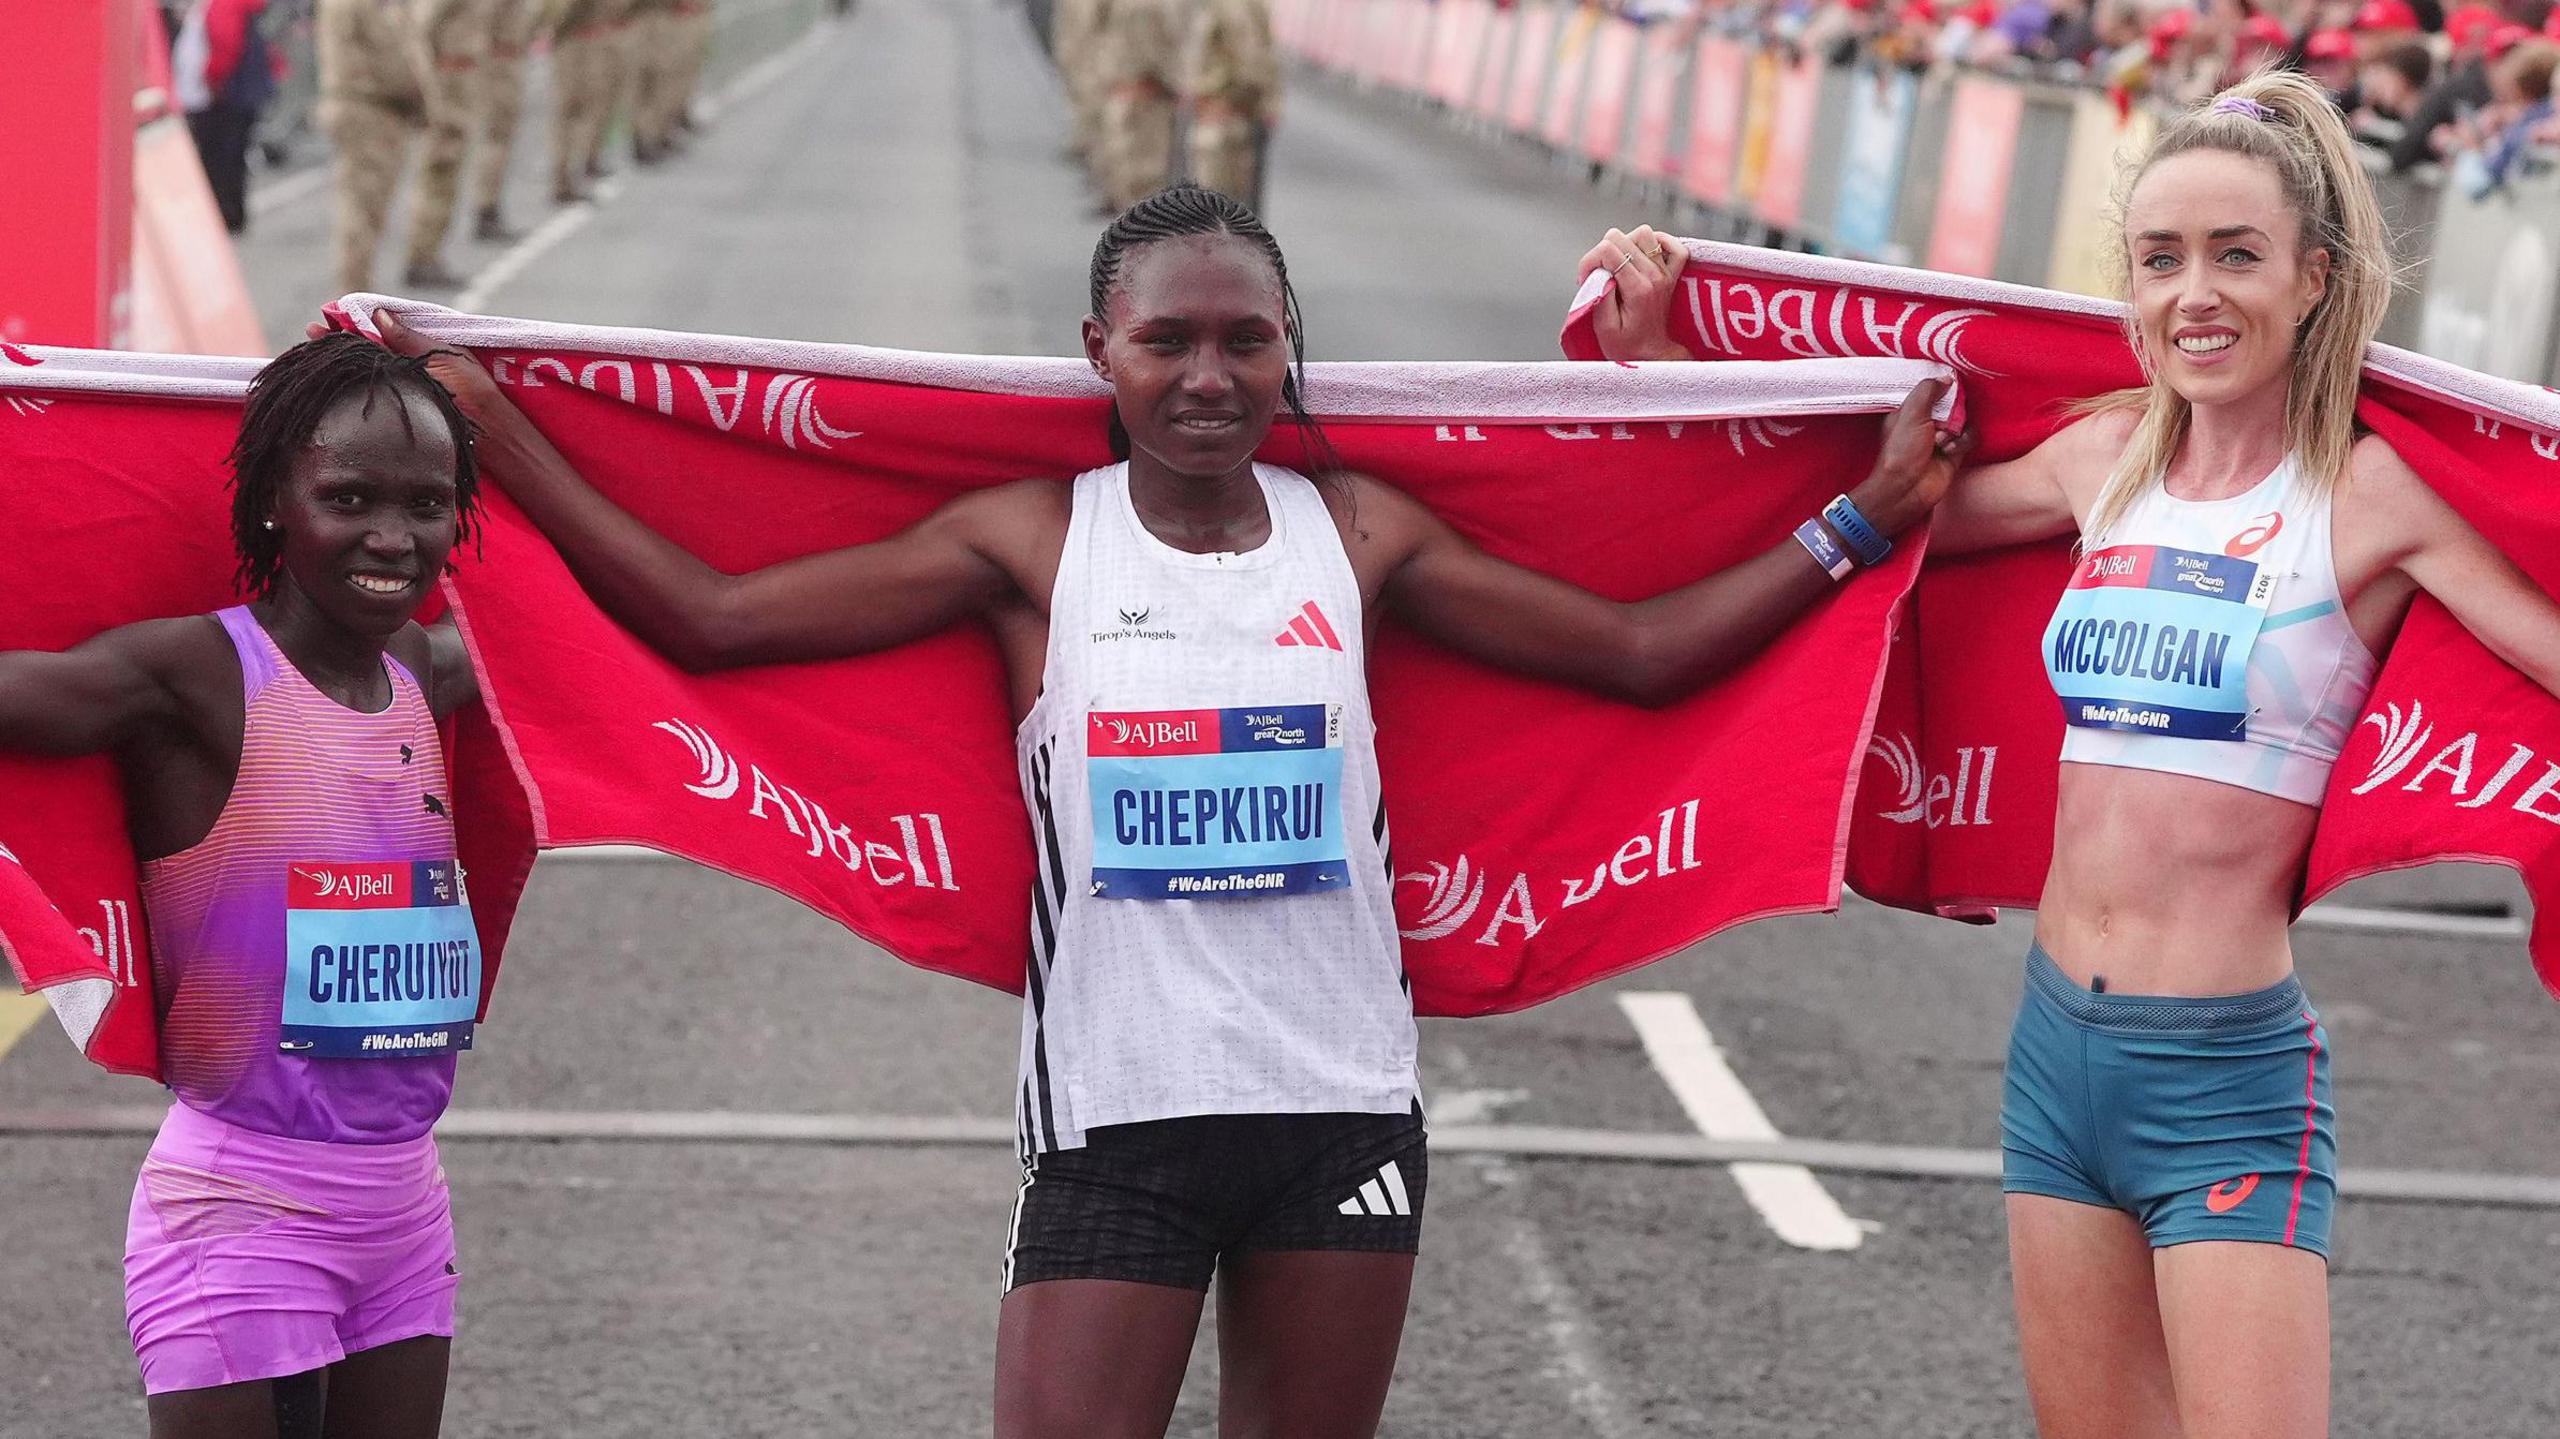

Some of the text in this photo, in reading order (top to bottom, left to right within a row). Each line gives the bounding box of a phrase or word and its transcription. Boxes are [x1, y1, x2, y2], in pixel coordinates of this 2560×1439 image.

[1682, 276, 1924, 358] AJBell
[2097, 555, 2137, 579] AJBell
[1091, 628, 1176, 644] Tirop's Angels
[2054, 618, 2232, 689] MCCOLGAN
[1254, 714, 1283, 727] AJBell
[2081, 705, 2171, 729] #WeAreTheGNR
[1130, 721, 1198, 748] AJBell
[1254, 728, 1305, 741] great north
[1113, 783, 1323, 846] CHEPKIRUI
[335, 874, 393, 901] AJBell
[1167, 872, 1285, 893] #WeAreTheGNR
[309, 940, 470, 1004] CHERUIYOT
[362, 1031, 448, 1051] #WeAreTheGNR
